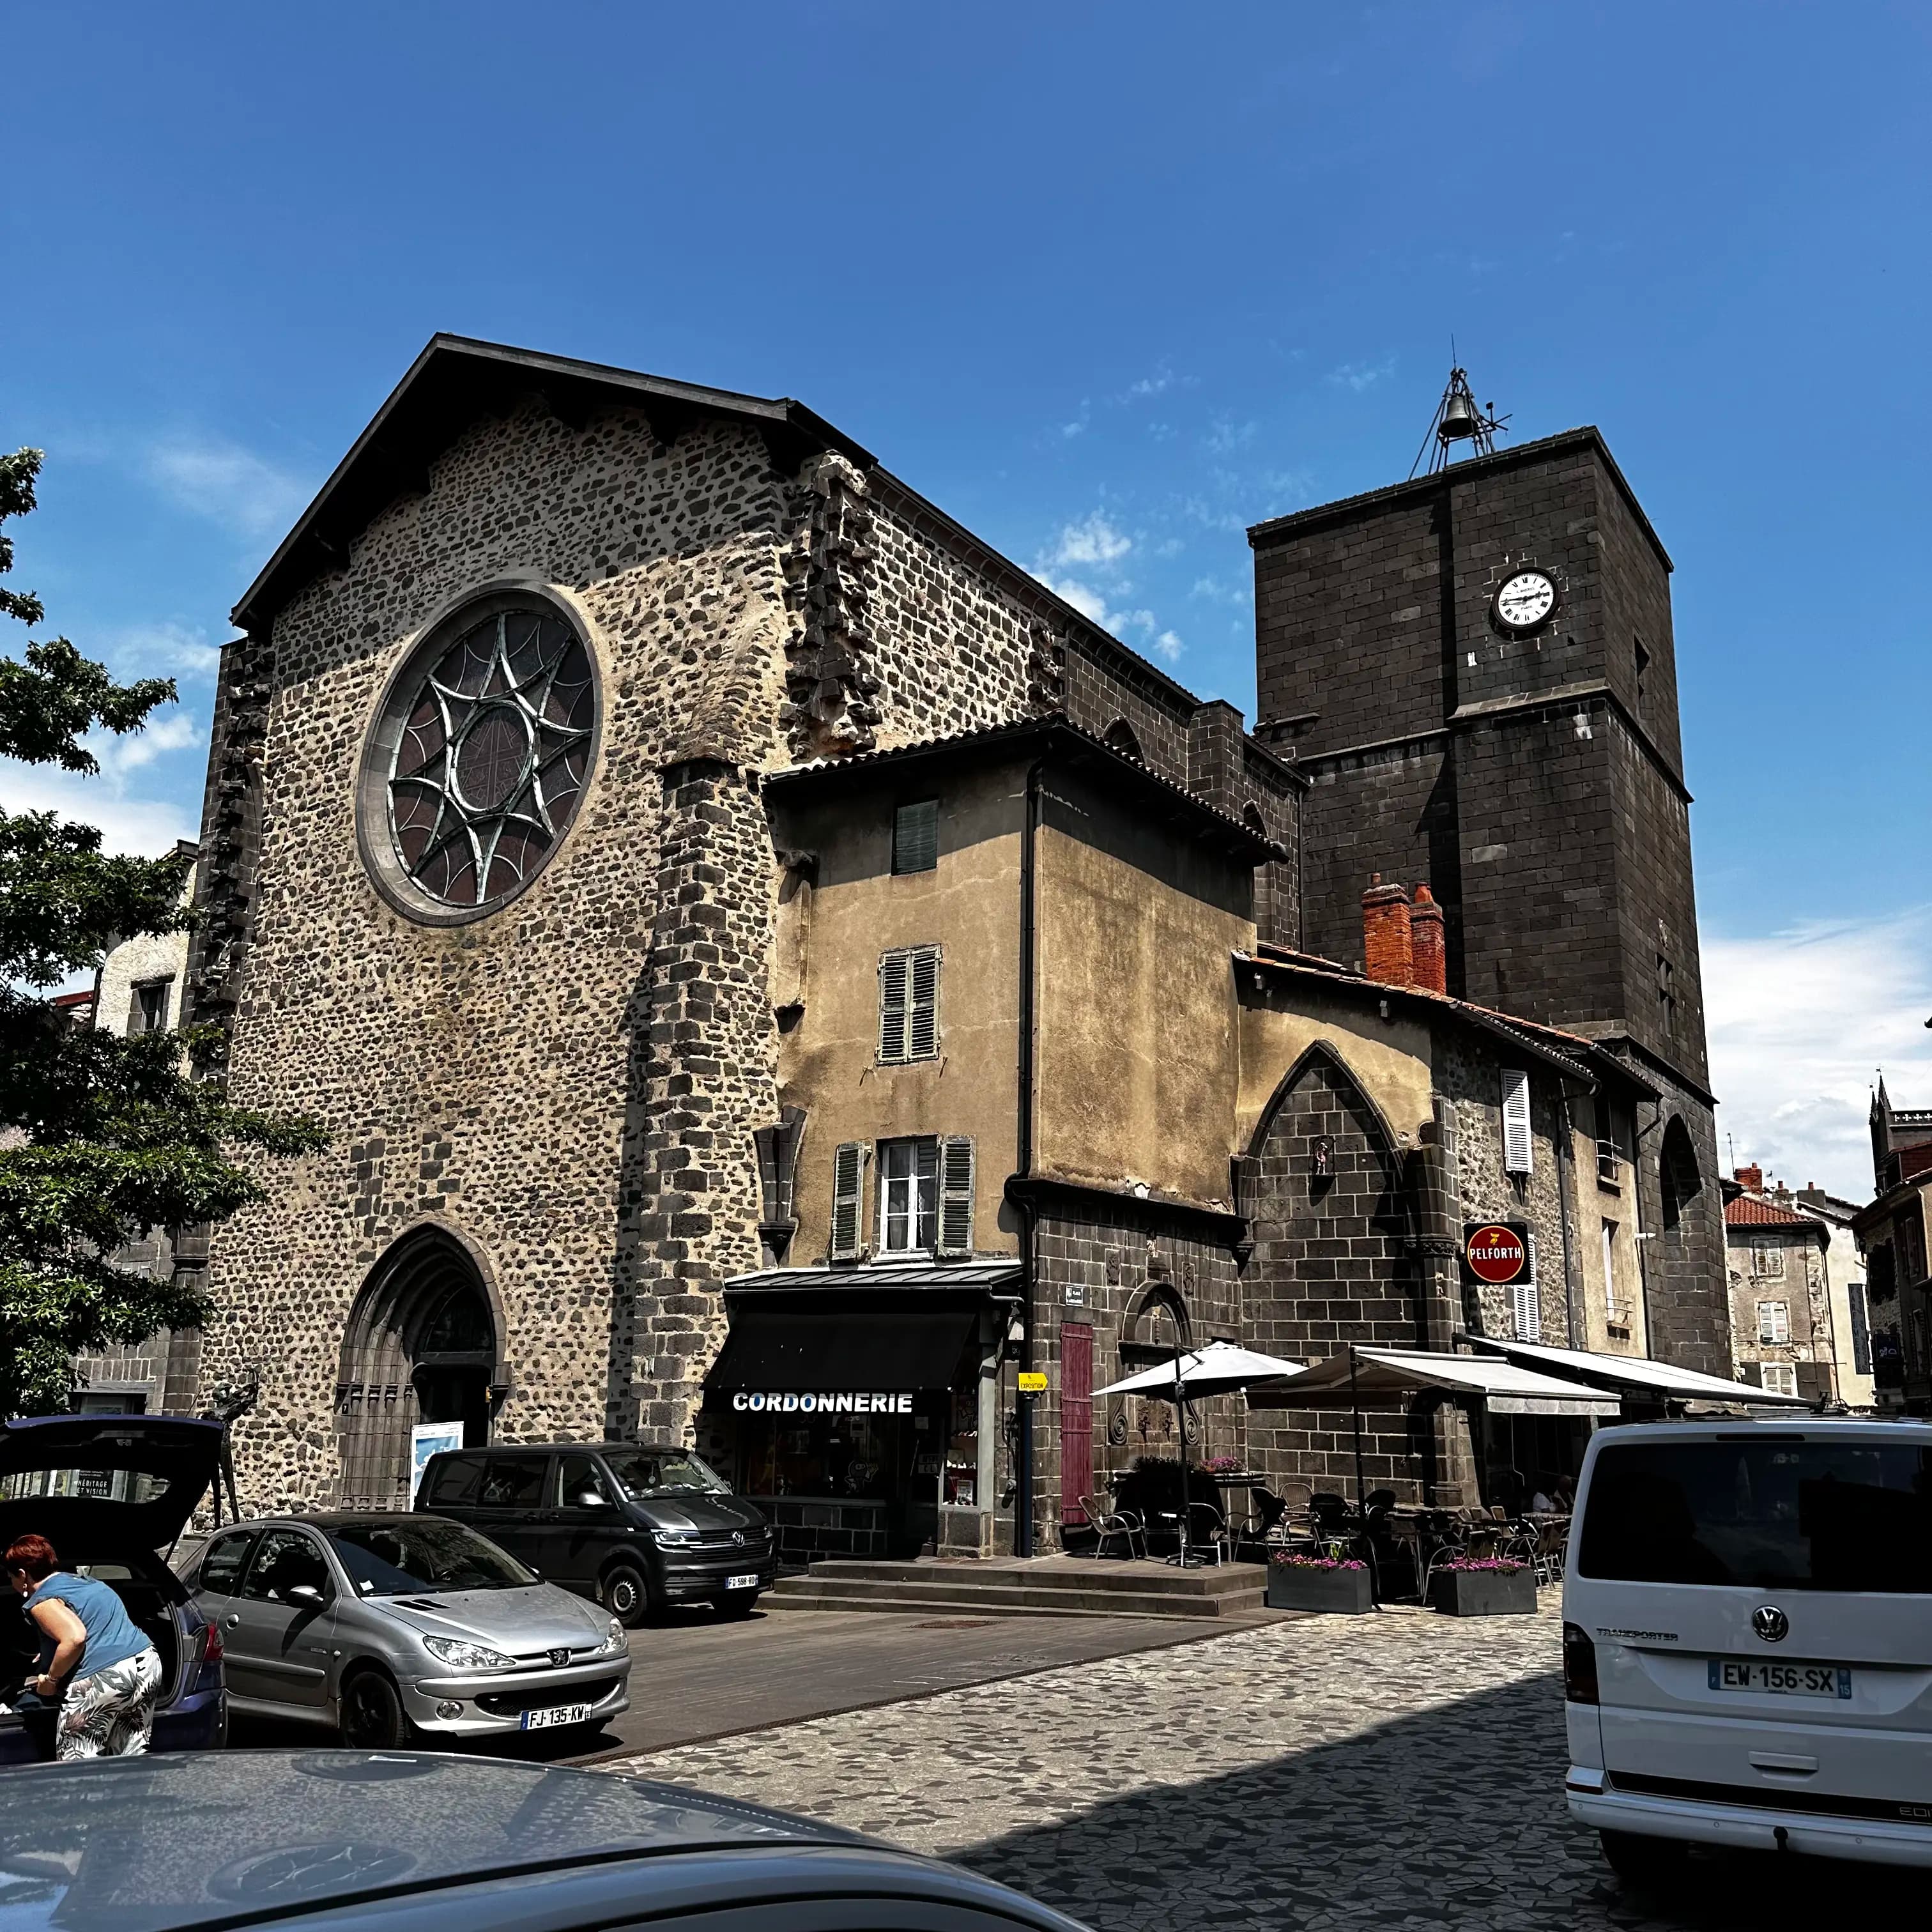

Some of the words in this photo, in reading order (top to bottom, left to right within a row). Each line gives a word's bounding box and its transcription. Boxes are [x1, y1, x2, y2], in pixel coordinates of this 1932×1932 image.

[1470, 1247, 1521, 1260] PELFORTH
[733, 1392, 913, 1413] CORDONNERIE
[78, 1479, 107, 1488] HÉRITAGE
[1596, 1628, 1678, 1641] TRANSPORTER
[1839, 1685, 1850, 1696] 15
[1899, 1807, 1932, 1818] EDI
